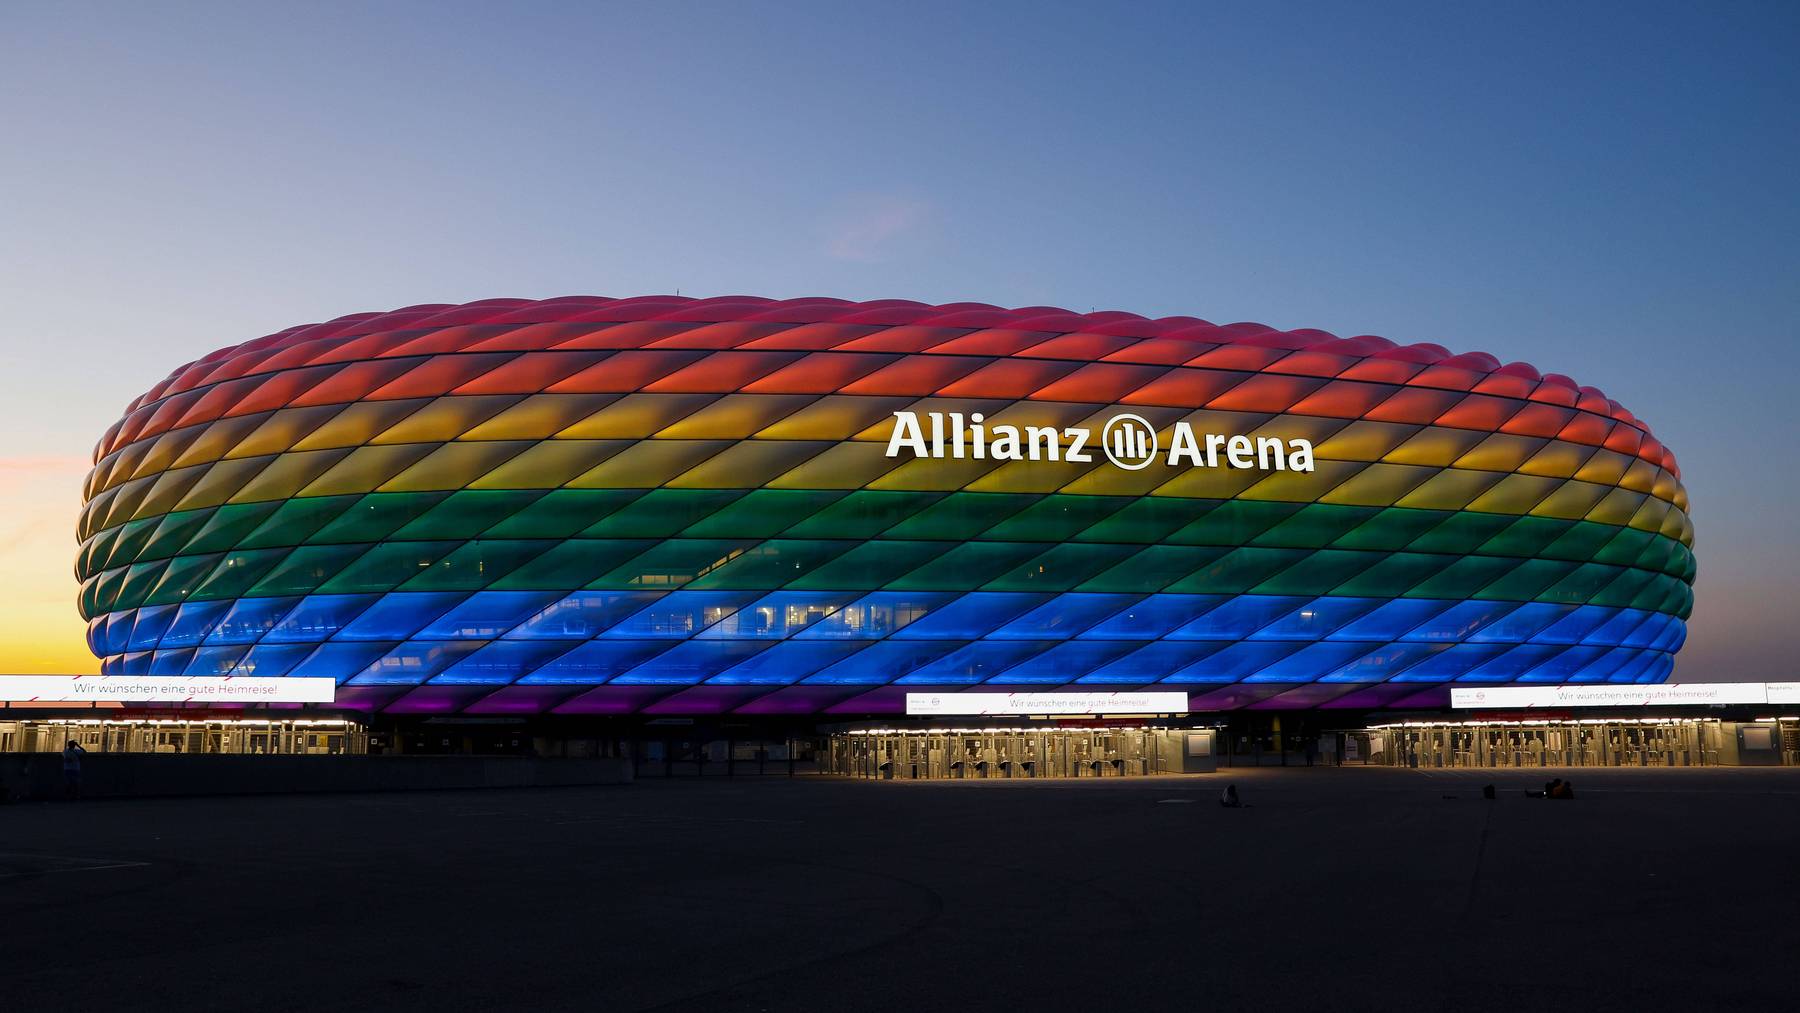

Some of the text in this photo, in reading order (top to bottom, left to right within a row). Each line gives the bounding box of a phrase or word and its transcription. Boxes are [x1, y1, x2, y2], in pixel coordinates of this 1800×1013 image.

[886, 411, 1315, 472] Allianz Arena
[74, 682, 278, 695] Wir wünschen eine gute Heimreise!
[1558, 689, 1718, 701] Wir wünschen eine gute Heimreise!
[1009, 699, 1024, 708] Wir
[1069, 699, 1086, 708] eine
[1088, 699, 1106, 708] gute
